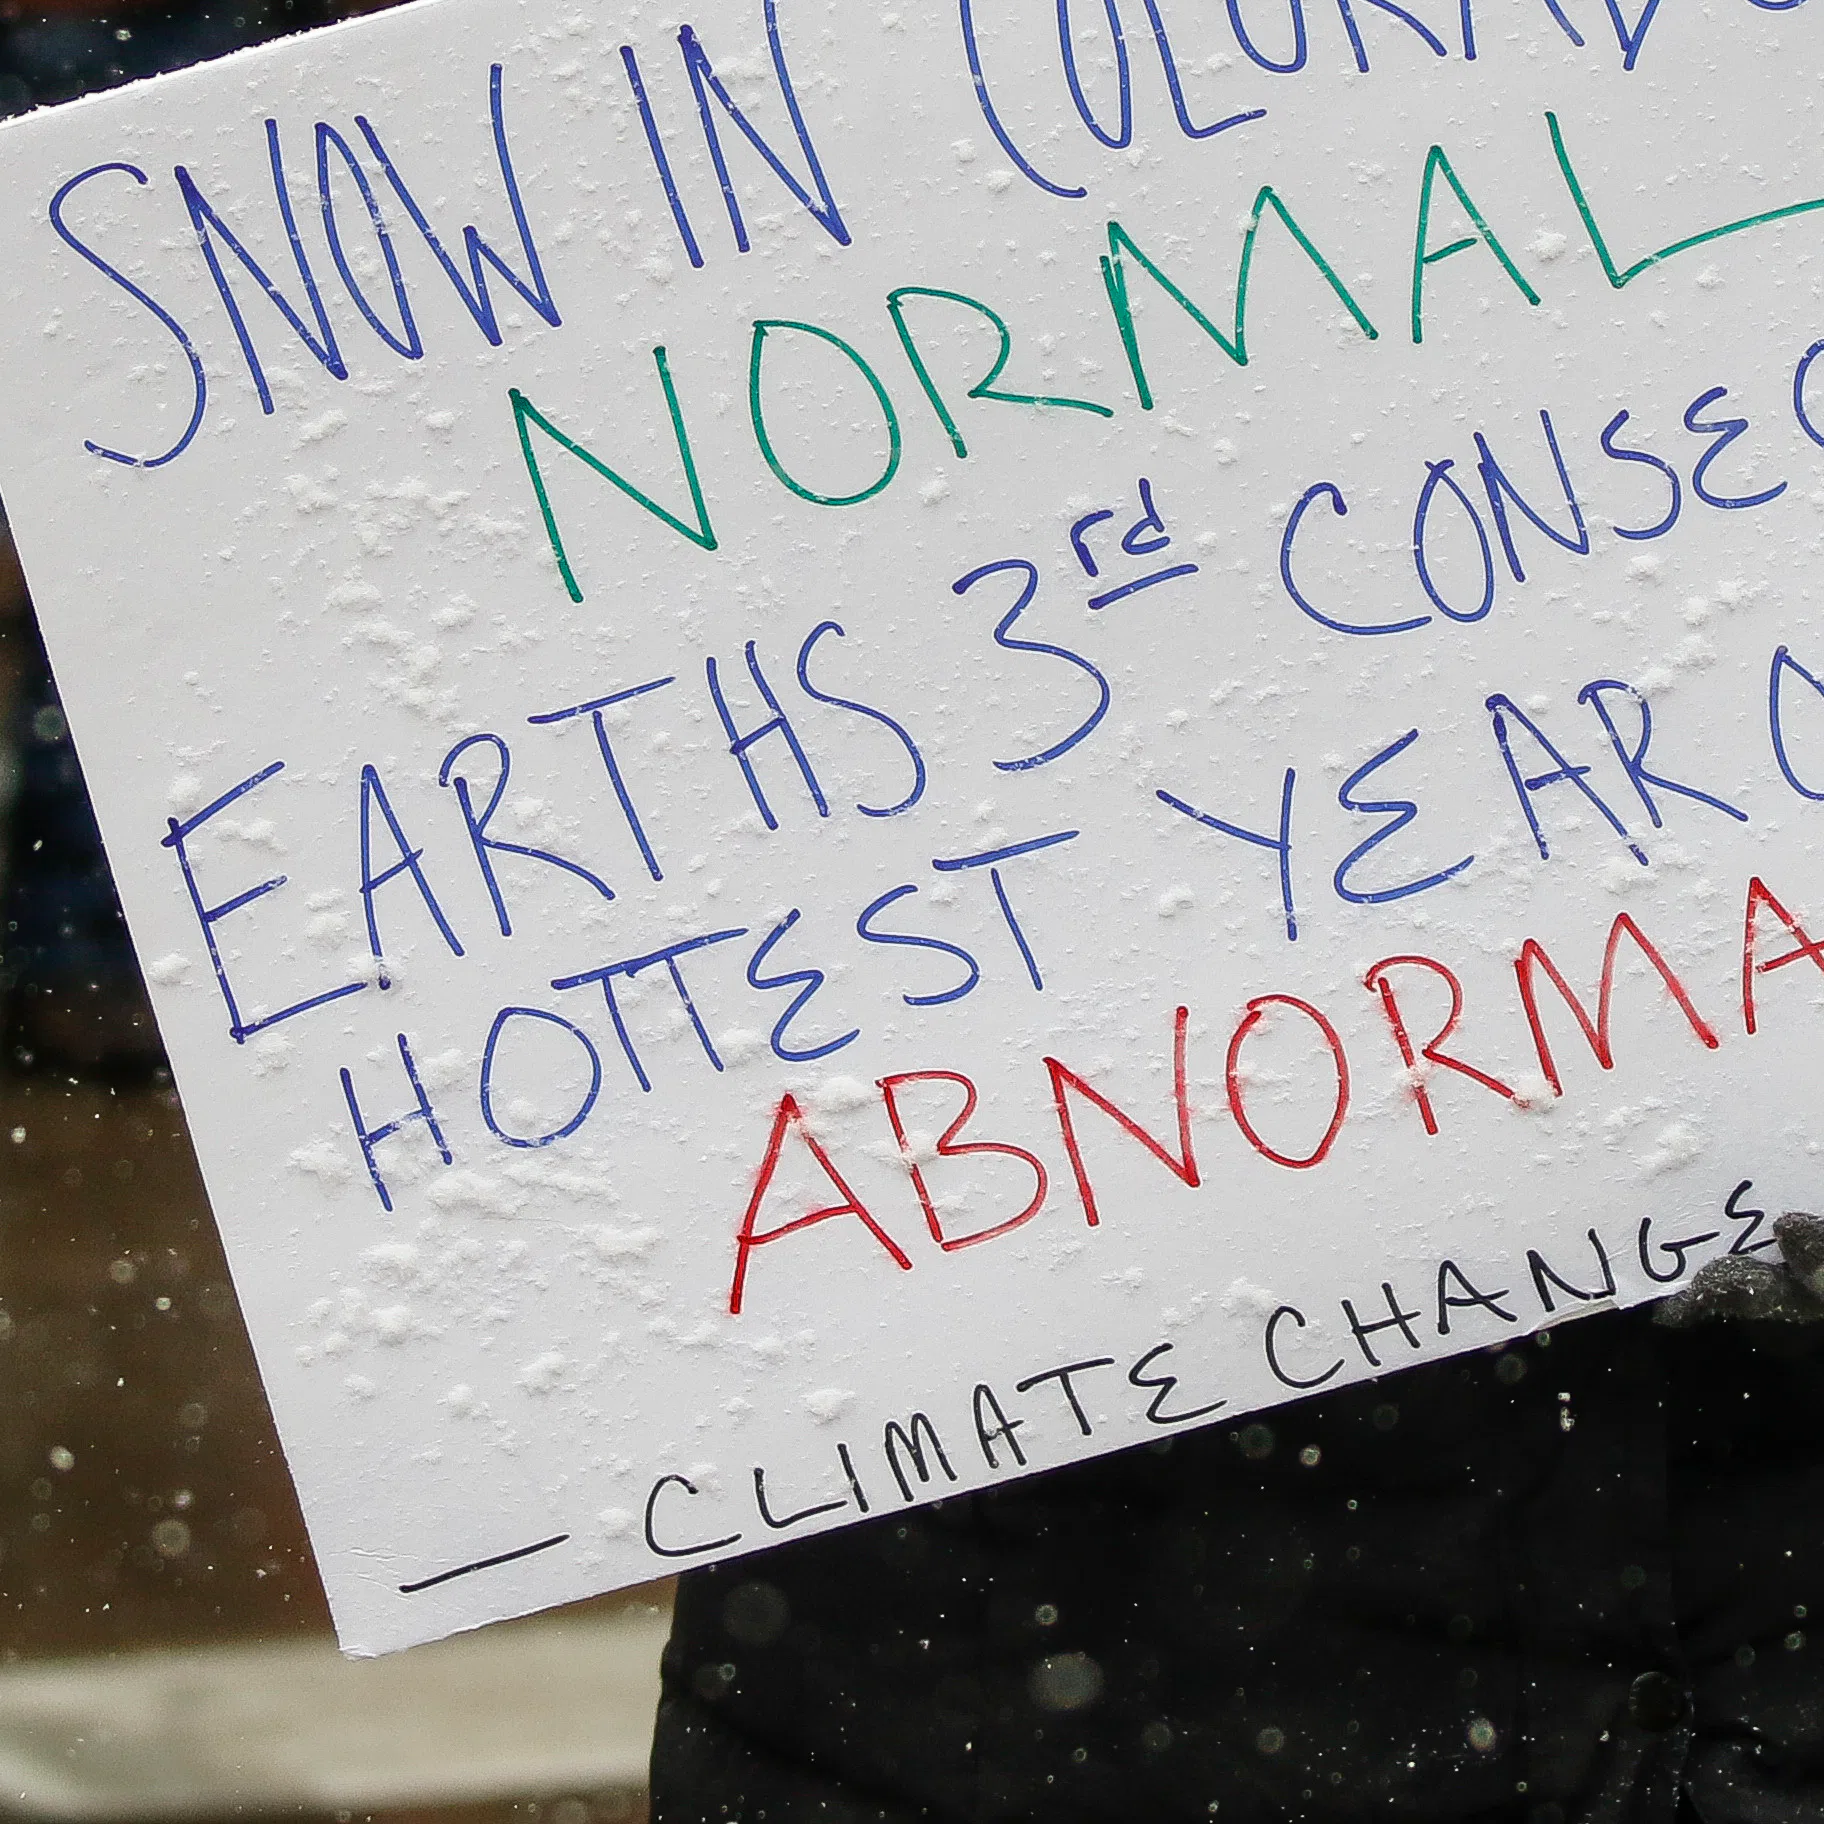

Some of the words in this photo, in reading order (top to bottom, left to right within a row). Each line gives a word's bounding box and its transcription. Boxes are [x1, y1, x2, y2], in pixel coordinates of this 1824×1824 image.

[50, 66, 561, 466] SNOW
[163, 622, 925, 1043] EARTHS
[949, 479, 1198, 772] 3rd
[341, 832, 1076, 1209] HOTTEST
[1158, 681, 1745, 939] YEAR
[646, 1344, 1221, 1558] CLIMATE
[1264, 1179, 1777, 1389] CHANGE
